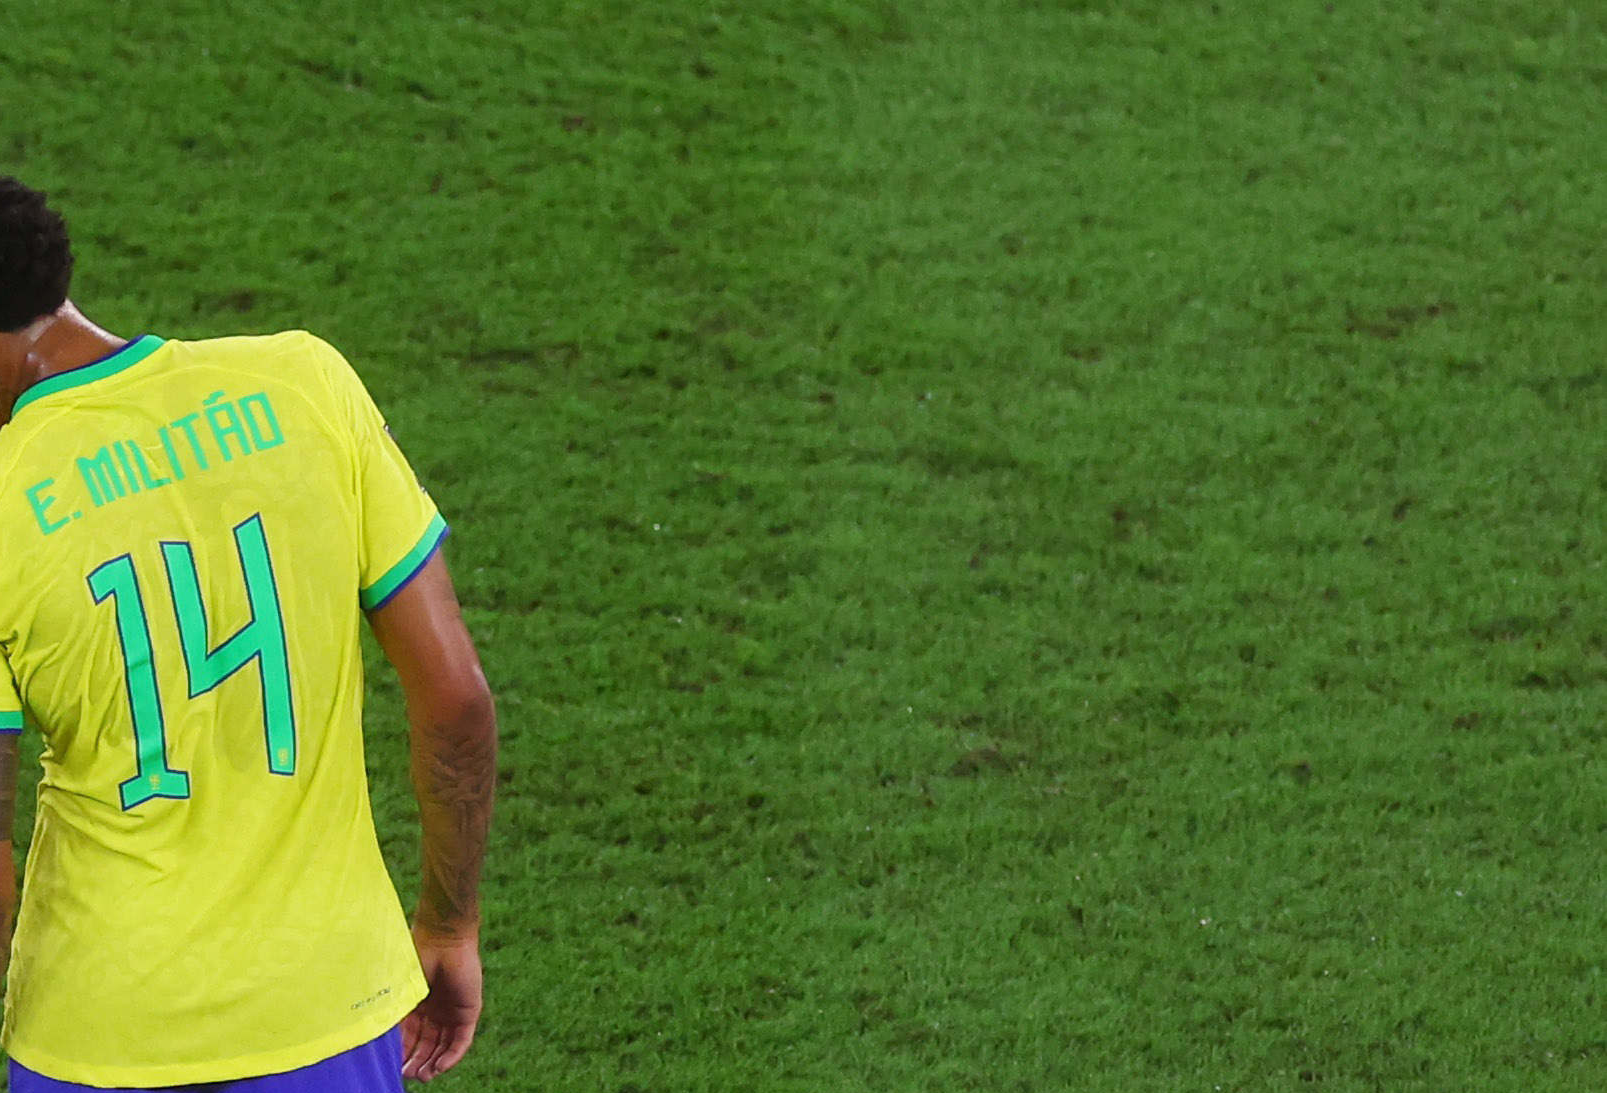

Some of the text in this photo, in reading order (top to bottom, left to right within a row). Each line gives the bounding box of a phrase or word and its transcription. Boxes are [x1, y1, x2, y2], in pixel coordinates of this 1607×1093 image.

[25, 390, 285, 535] E. MILITÃO
[86, 512, 296, 811] 14
